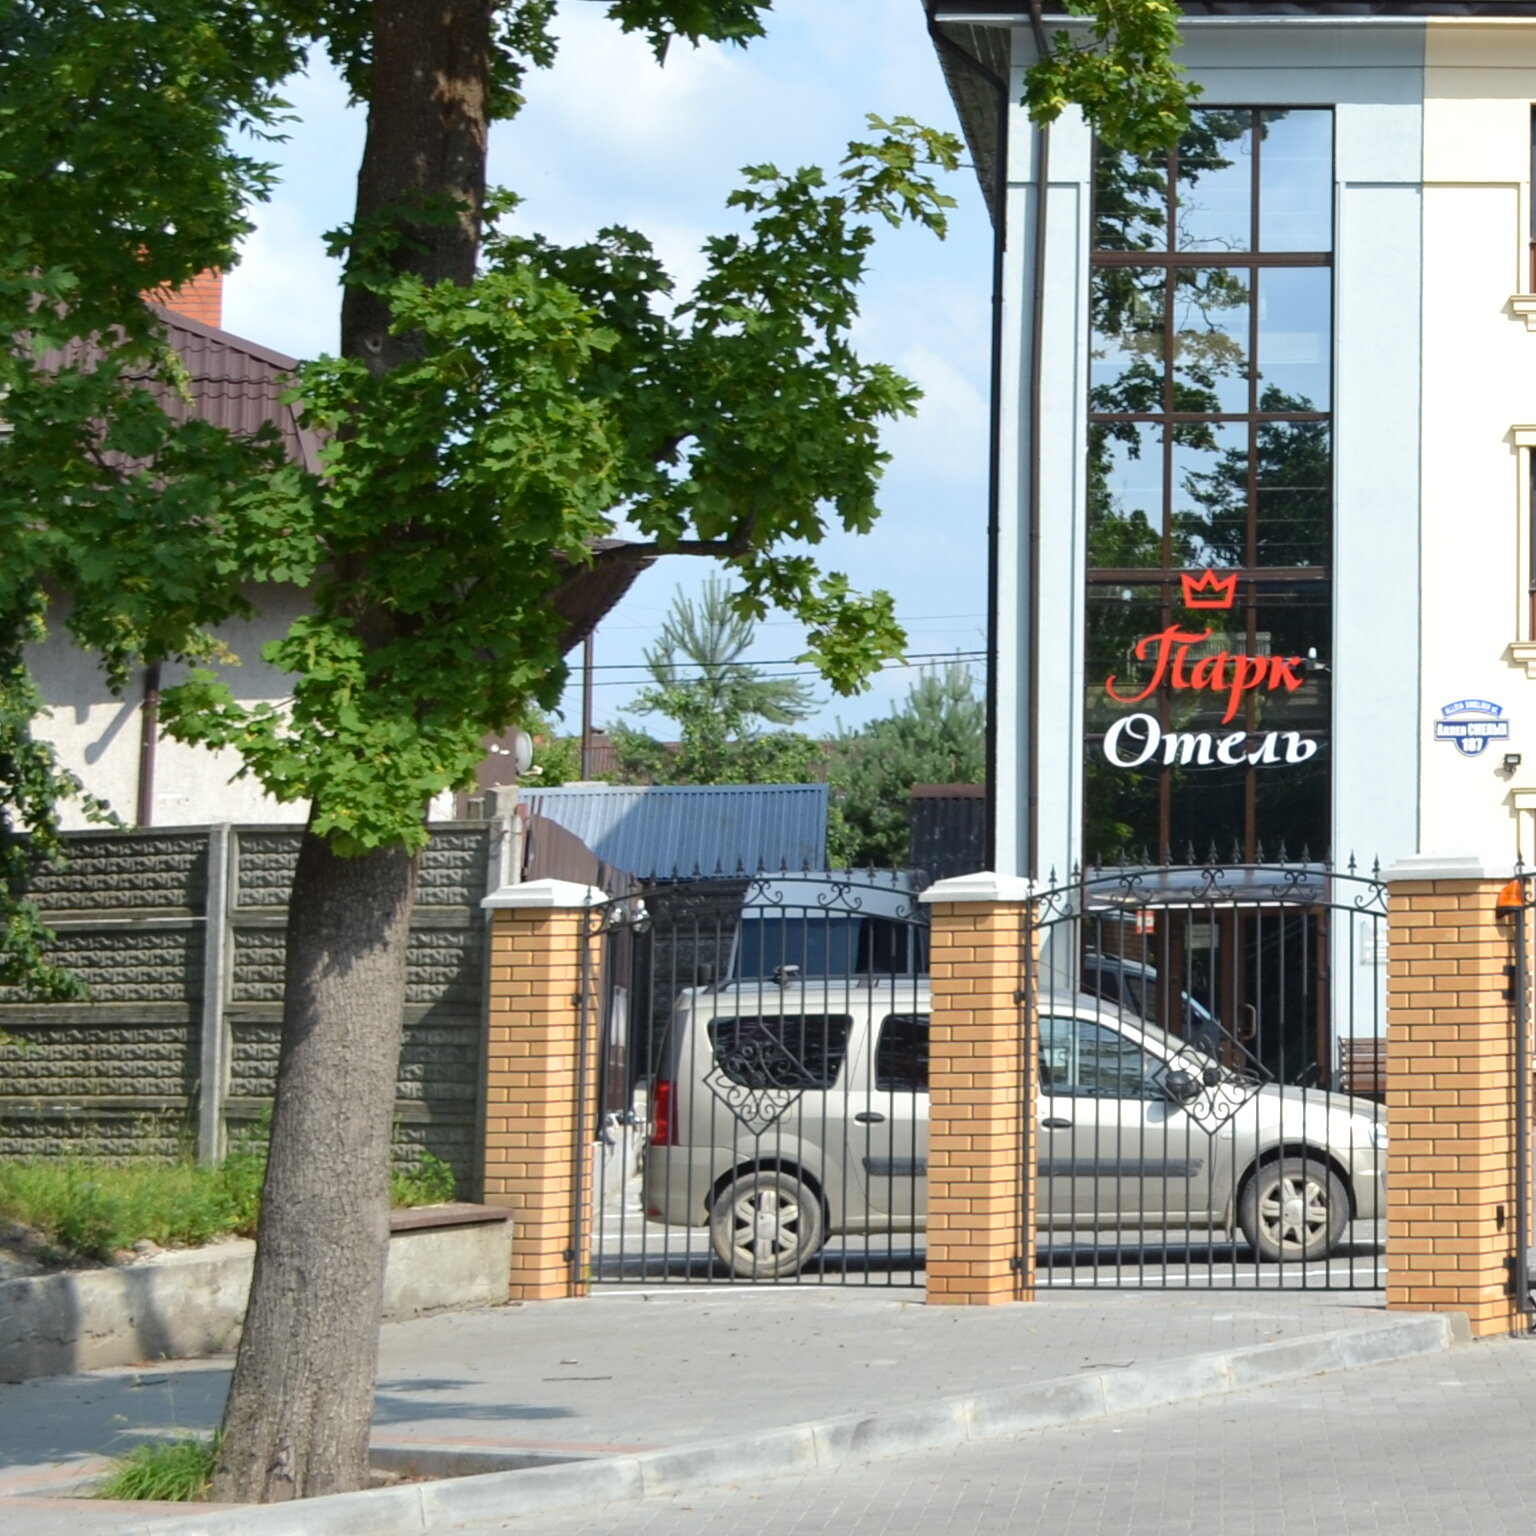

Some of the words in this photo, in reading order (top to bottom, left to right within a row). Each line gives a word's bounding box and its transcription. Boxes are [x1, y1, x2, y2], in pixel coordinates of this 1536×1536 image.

[1105, 624, 1303, 724] Парк
[1103, 713, 1317, 767] Отель
[1462, 737, 1483, 752] 187
